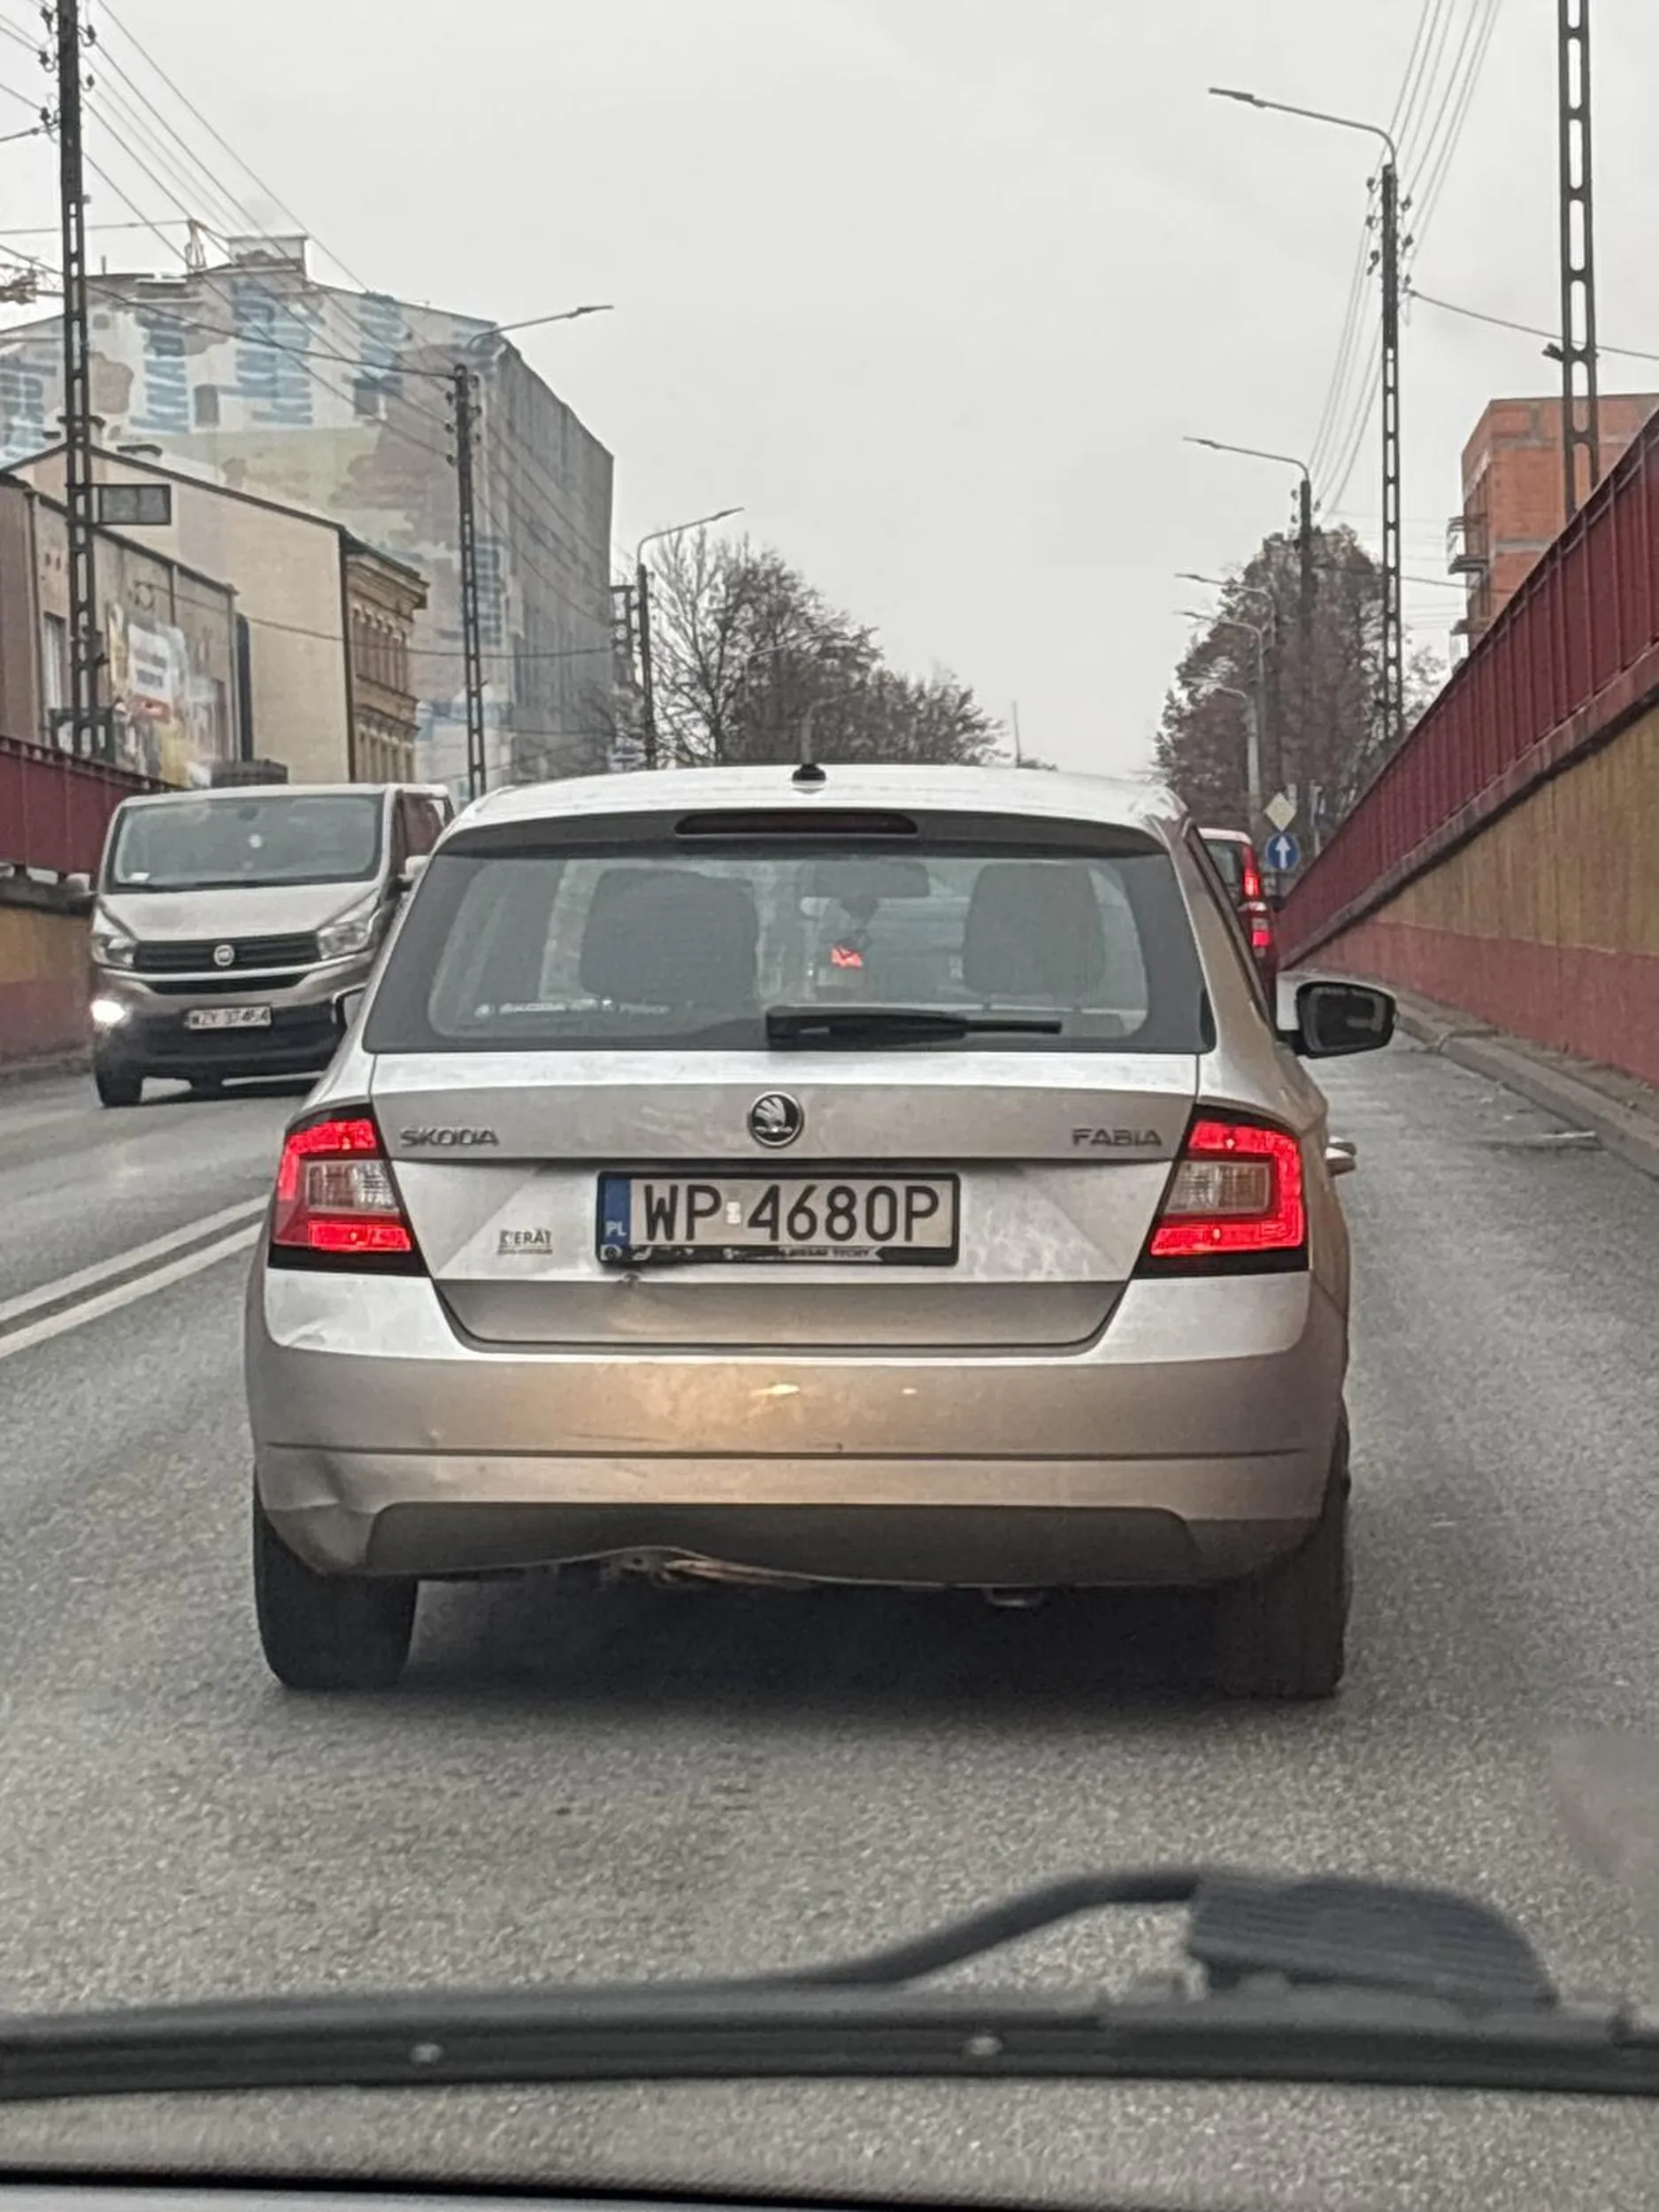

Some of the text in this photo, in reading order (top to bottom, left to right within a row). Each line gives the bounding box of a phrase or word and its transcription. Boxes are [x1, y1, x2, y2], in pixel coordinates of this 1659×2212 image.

[1071, 1128, 1163, 1148] FABIA
[643, 1184, 722, 1242] WP
[605, 1221, 627, 1237] PL
